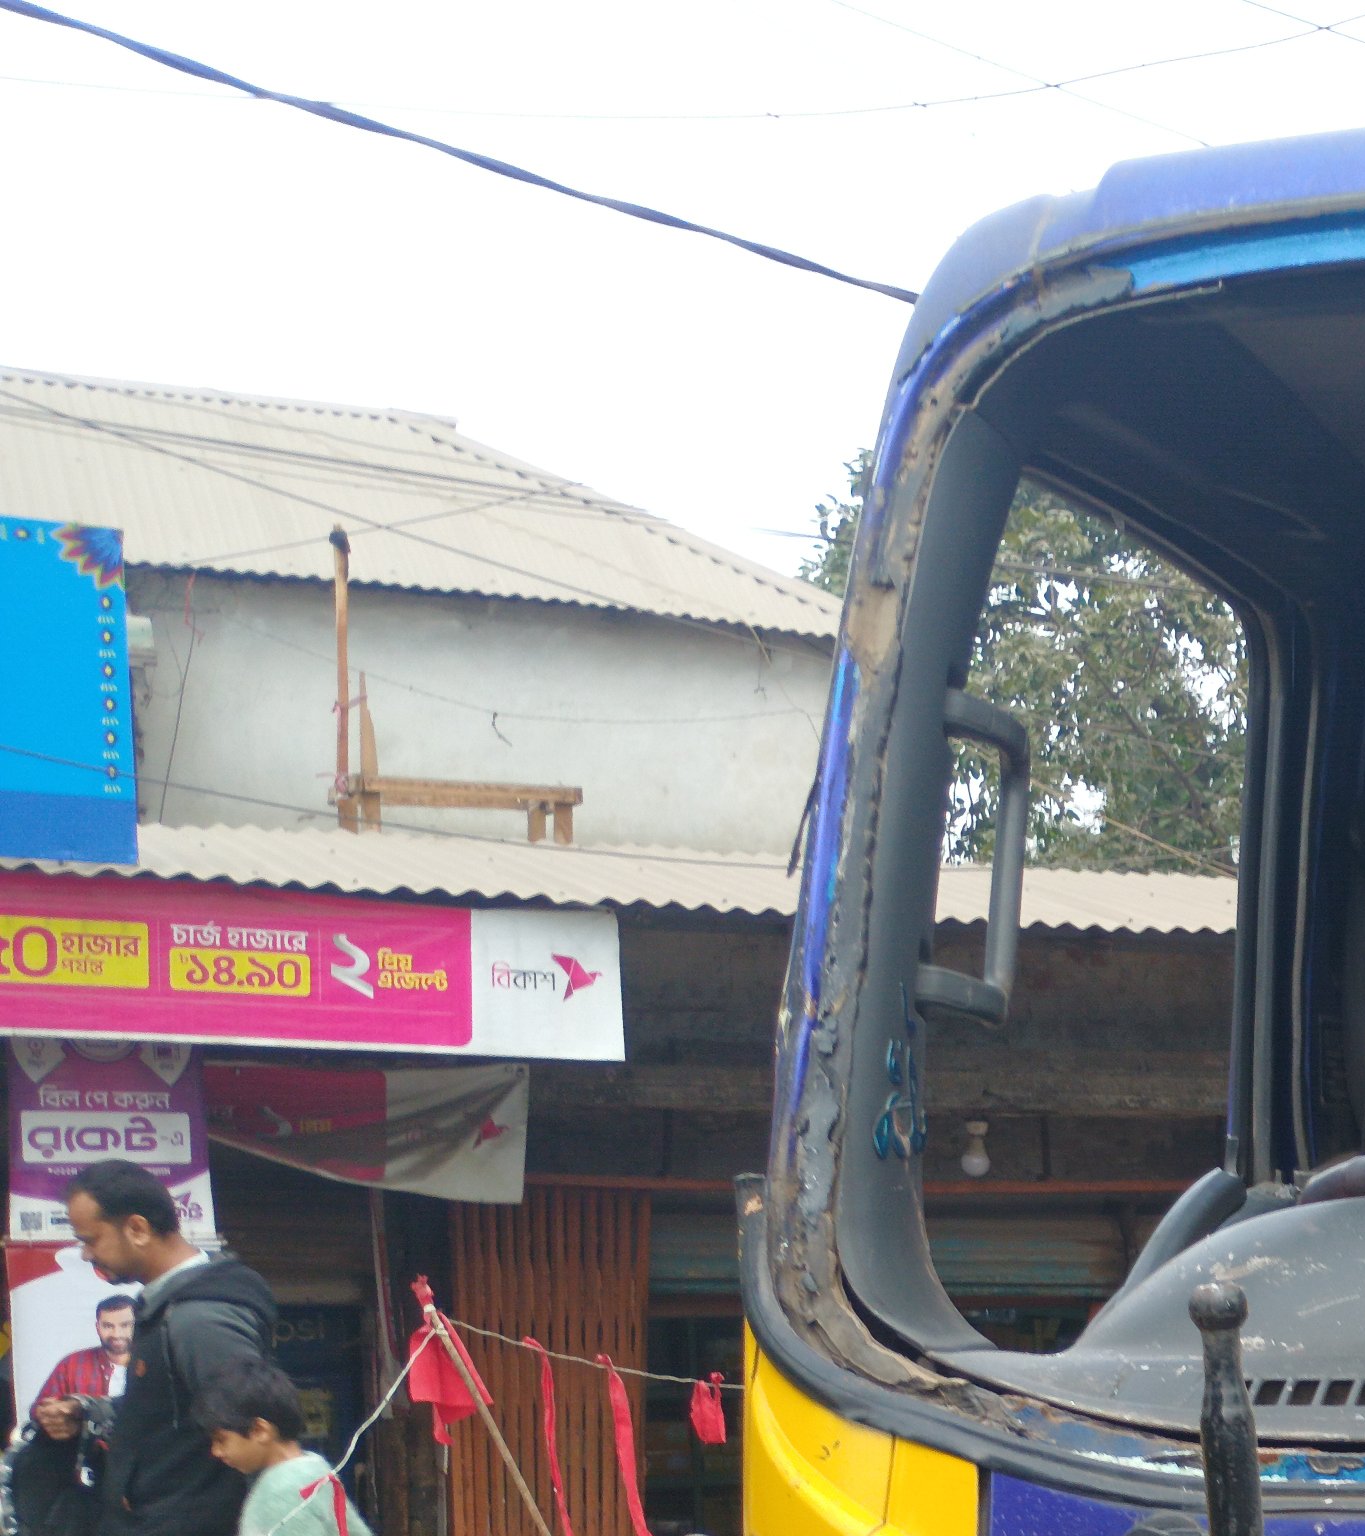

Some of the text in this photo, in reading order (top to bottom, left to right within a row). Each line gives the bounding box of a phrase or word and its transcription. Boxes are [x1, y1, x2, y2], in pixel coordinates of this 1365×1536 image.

[61, 932, 141, 958] হাজার
[171, 920, 309, 953] চার্জ হাজারে
[492, 960, 556, 992] বিকাশ
